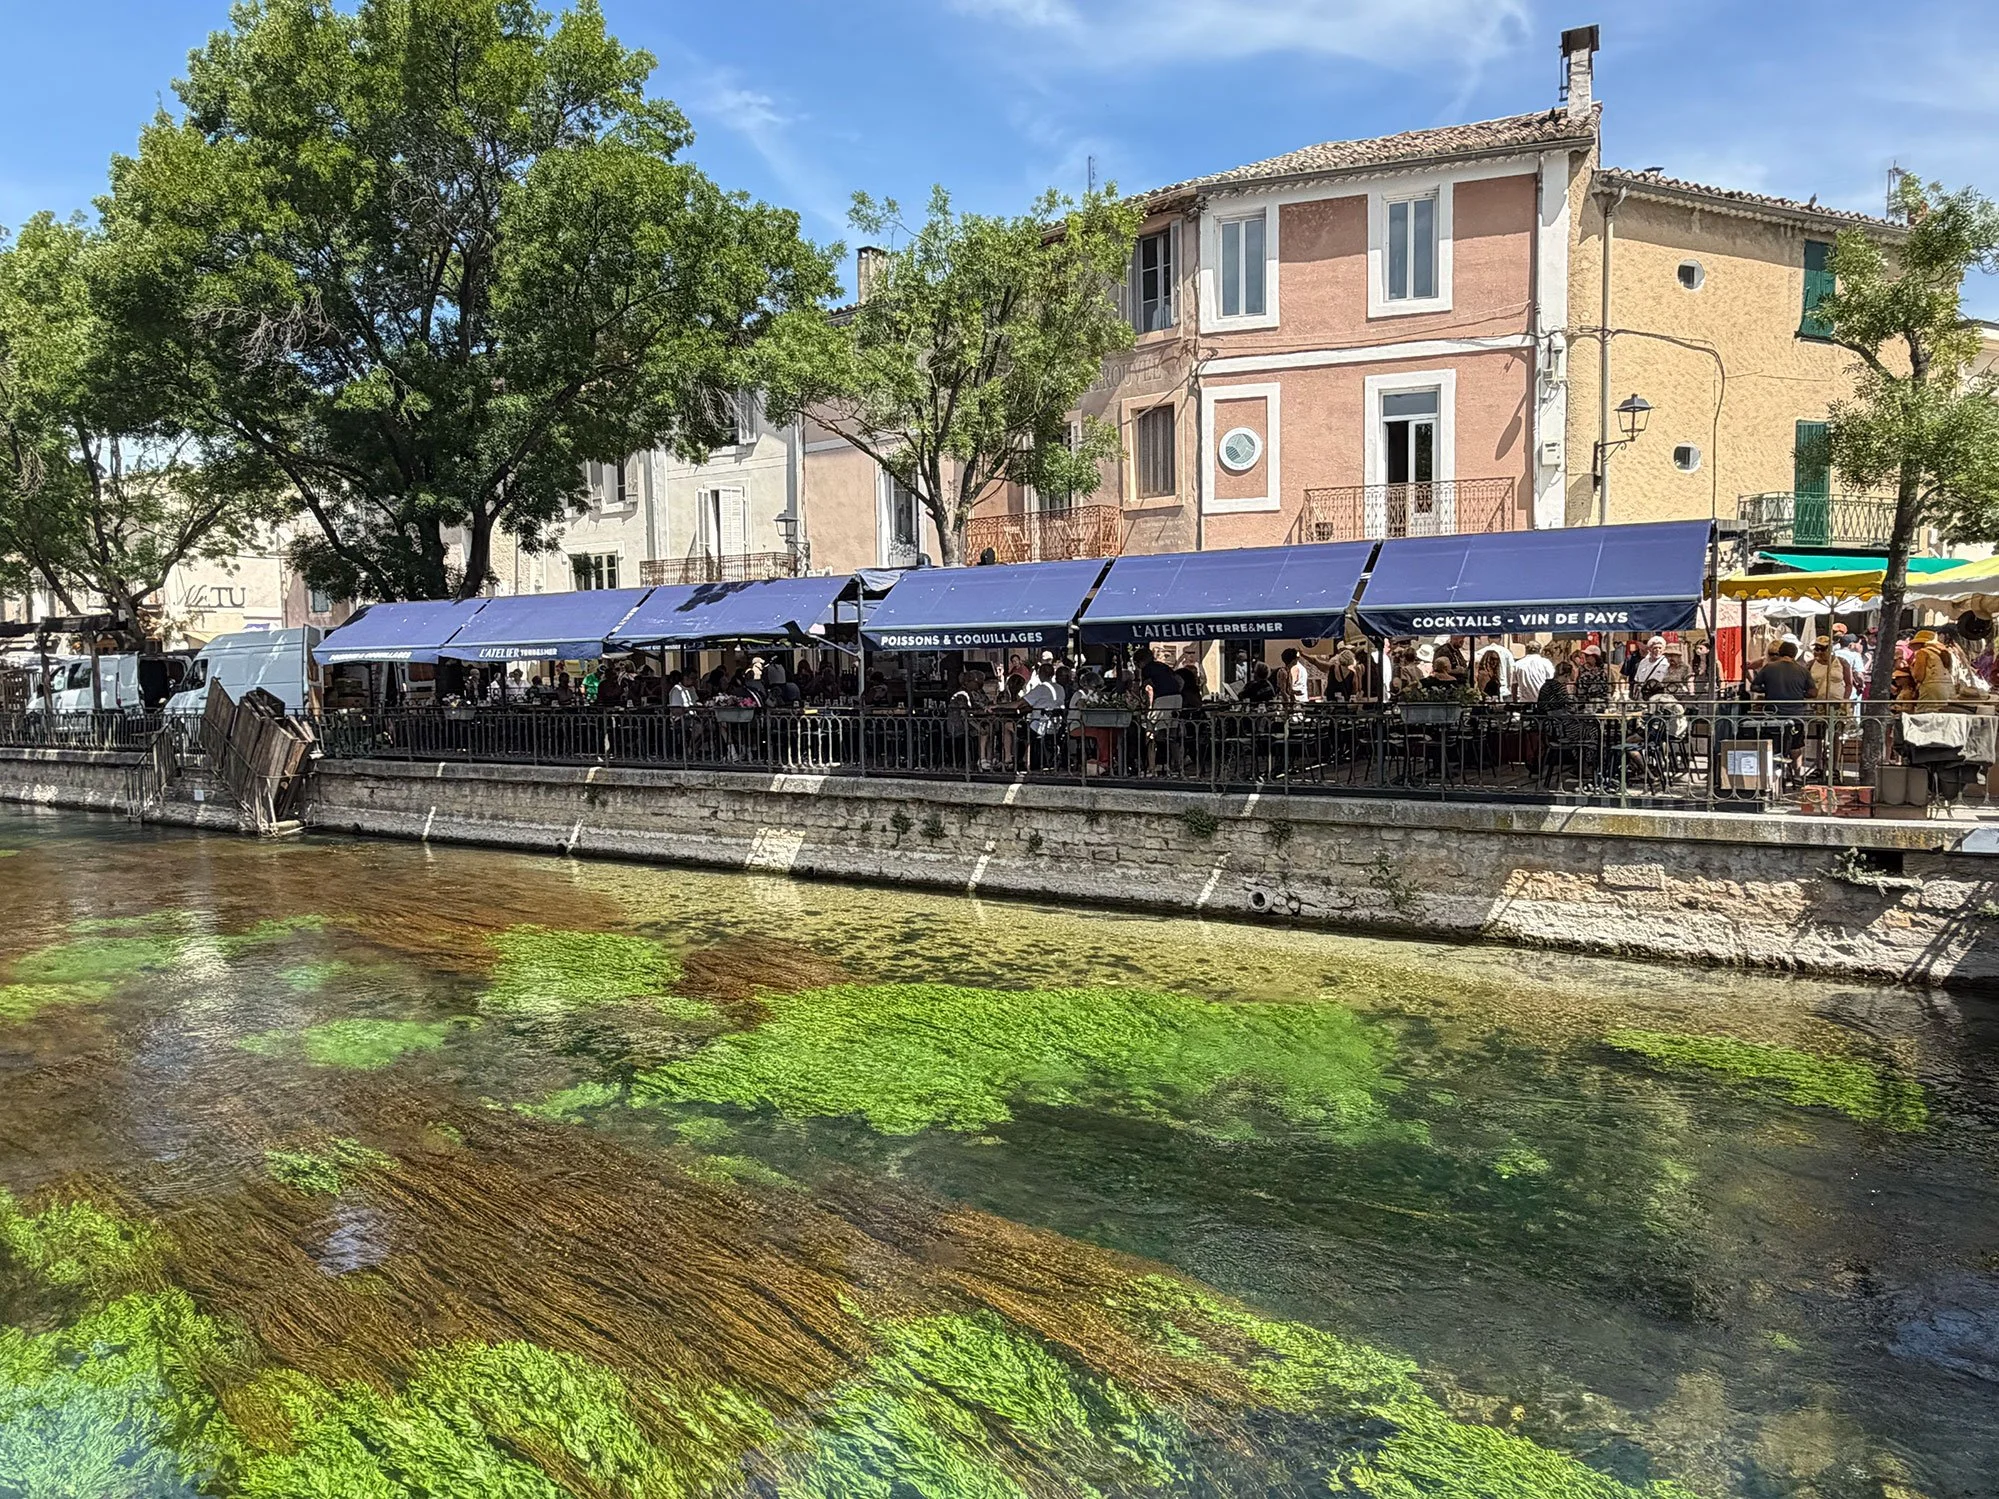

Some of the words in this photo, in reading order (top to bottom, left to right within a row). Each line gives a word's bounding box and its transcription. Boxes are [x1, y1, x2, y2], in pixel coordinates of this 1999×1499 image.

[210, 586, 247, 607] TU
[1412, 615, 1502, 628] COCKTAILS
[1519, 613, 1550, 626] VIN
[1555, 612, 1580, 625] DE
[1584, 611, 1629, 624] PAYS
[1132, 622, 1206, 638] L'ATELIER
[1207, 622, 1284, 634] TERRE&MER
[881, 634, 940, 646] POISSONS
[943, 633, 952, 645] &
[955, 632, 1043, 645] COQUILLAGES
[478, 647, 519, 659] L'ATELIER
